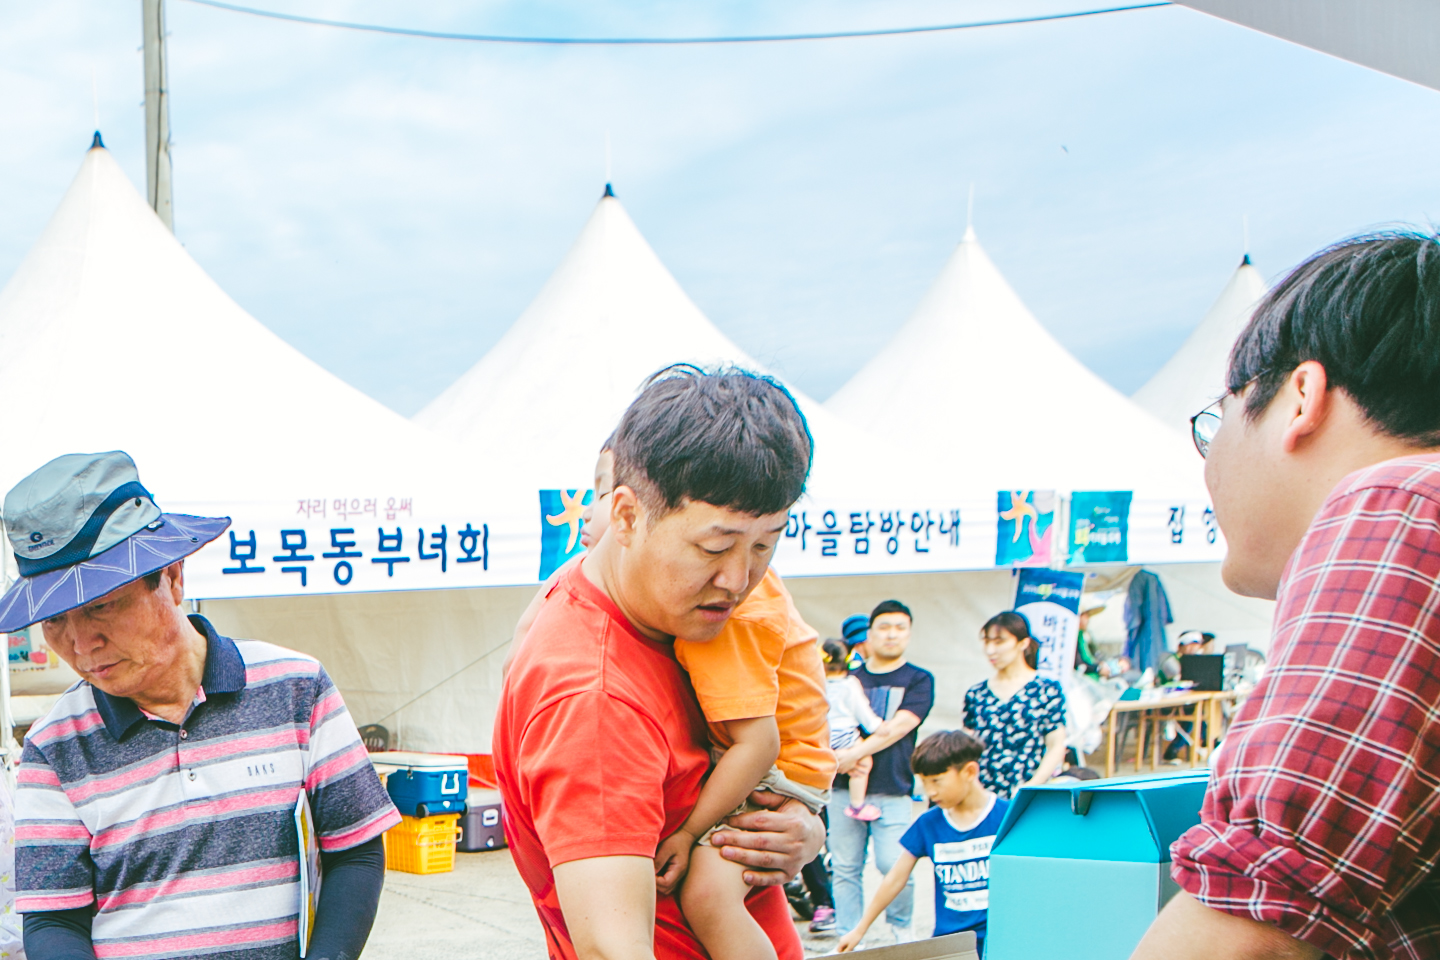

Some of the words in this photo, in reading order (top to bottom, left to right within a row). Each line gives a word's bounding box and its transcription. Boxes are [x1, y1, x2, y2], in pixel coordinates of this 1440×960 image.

[296, 499, 327, 519] 자리
[333, 498, 378, 521] 먹으러
[383, 497, 413, 521] 옵써
[785, 510, 961, 557] 마을탐방안내
[221, 522, 489, 587] 보목동부녀회
[247, 762, 275, 777] DAKS
